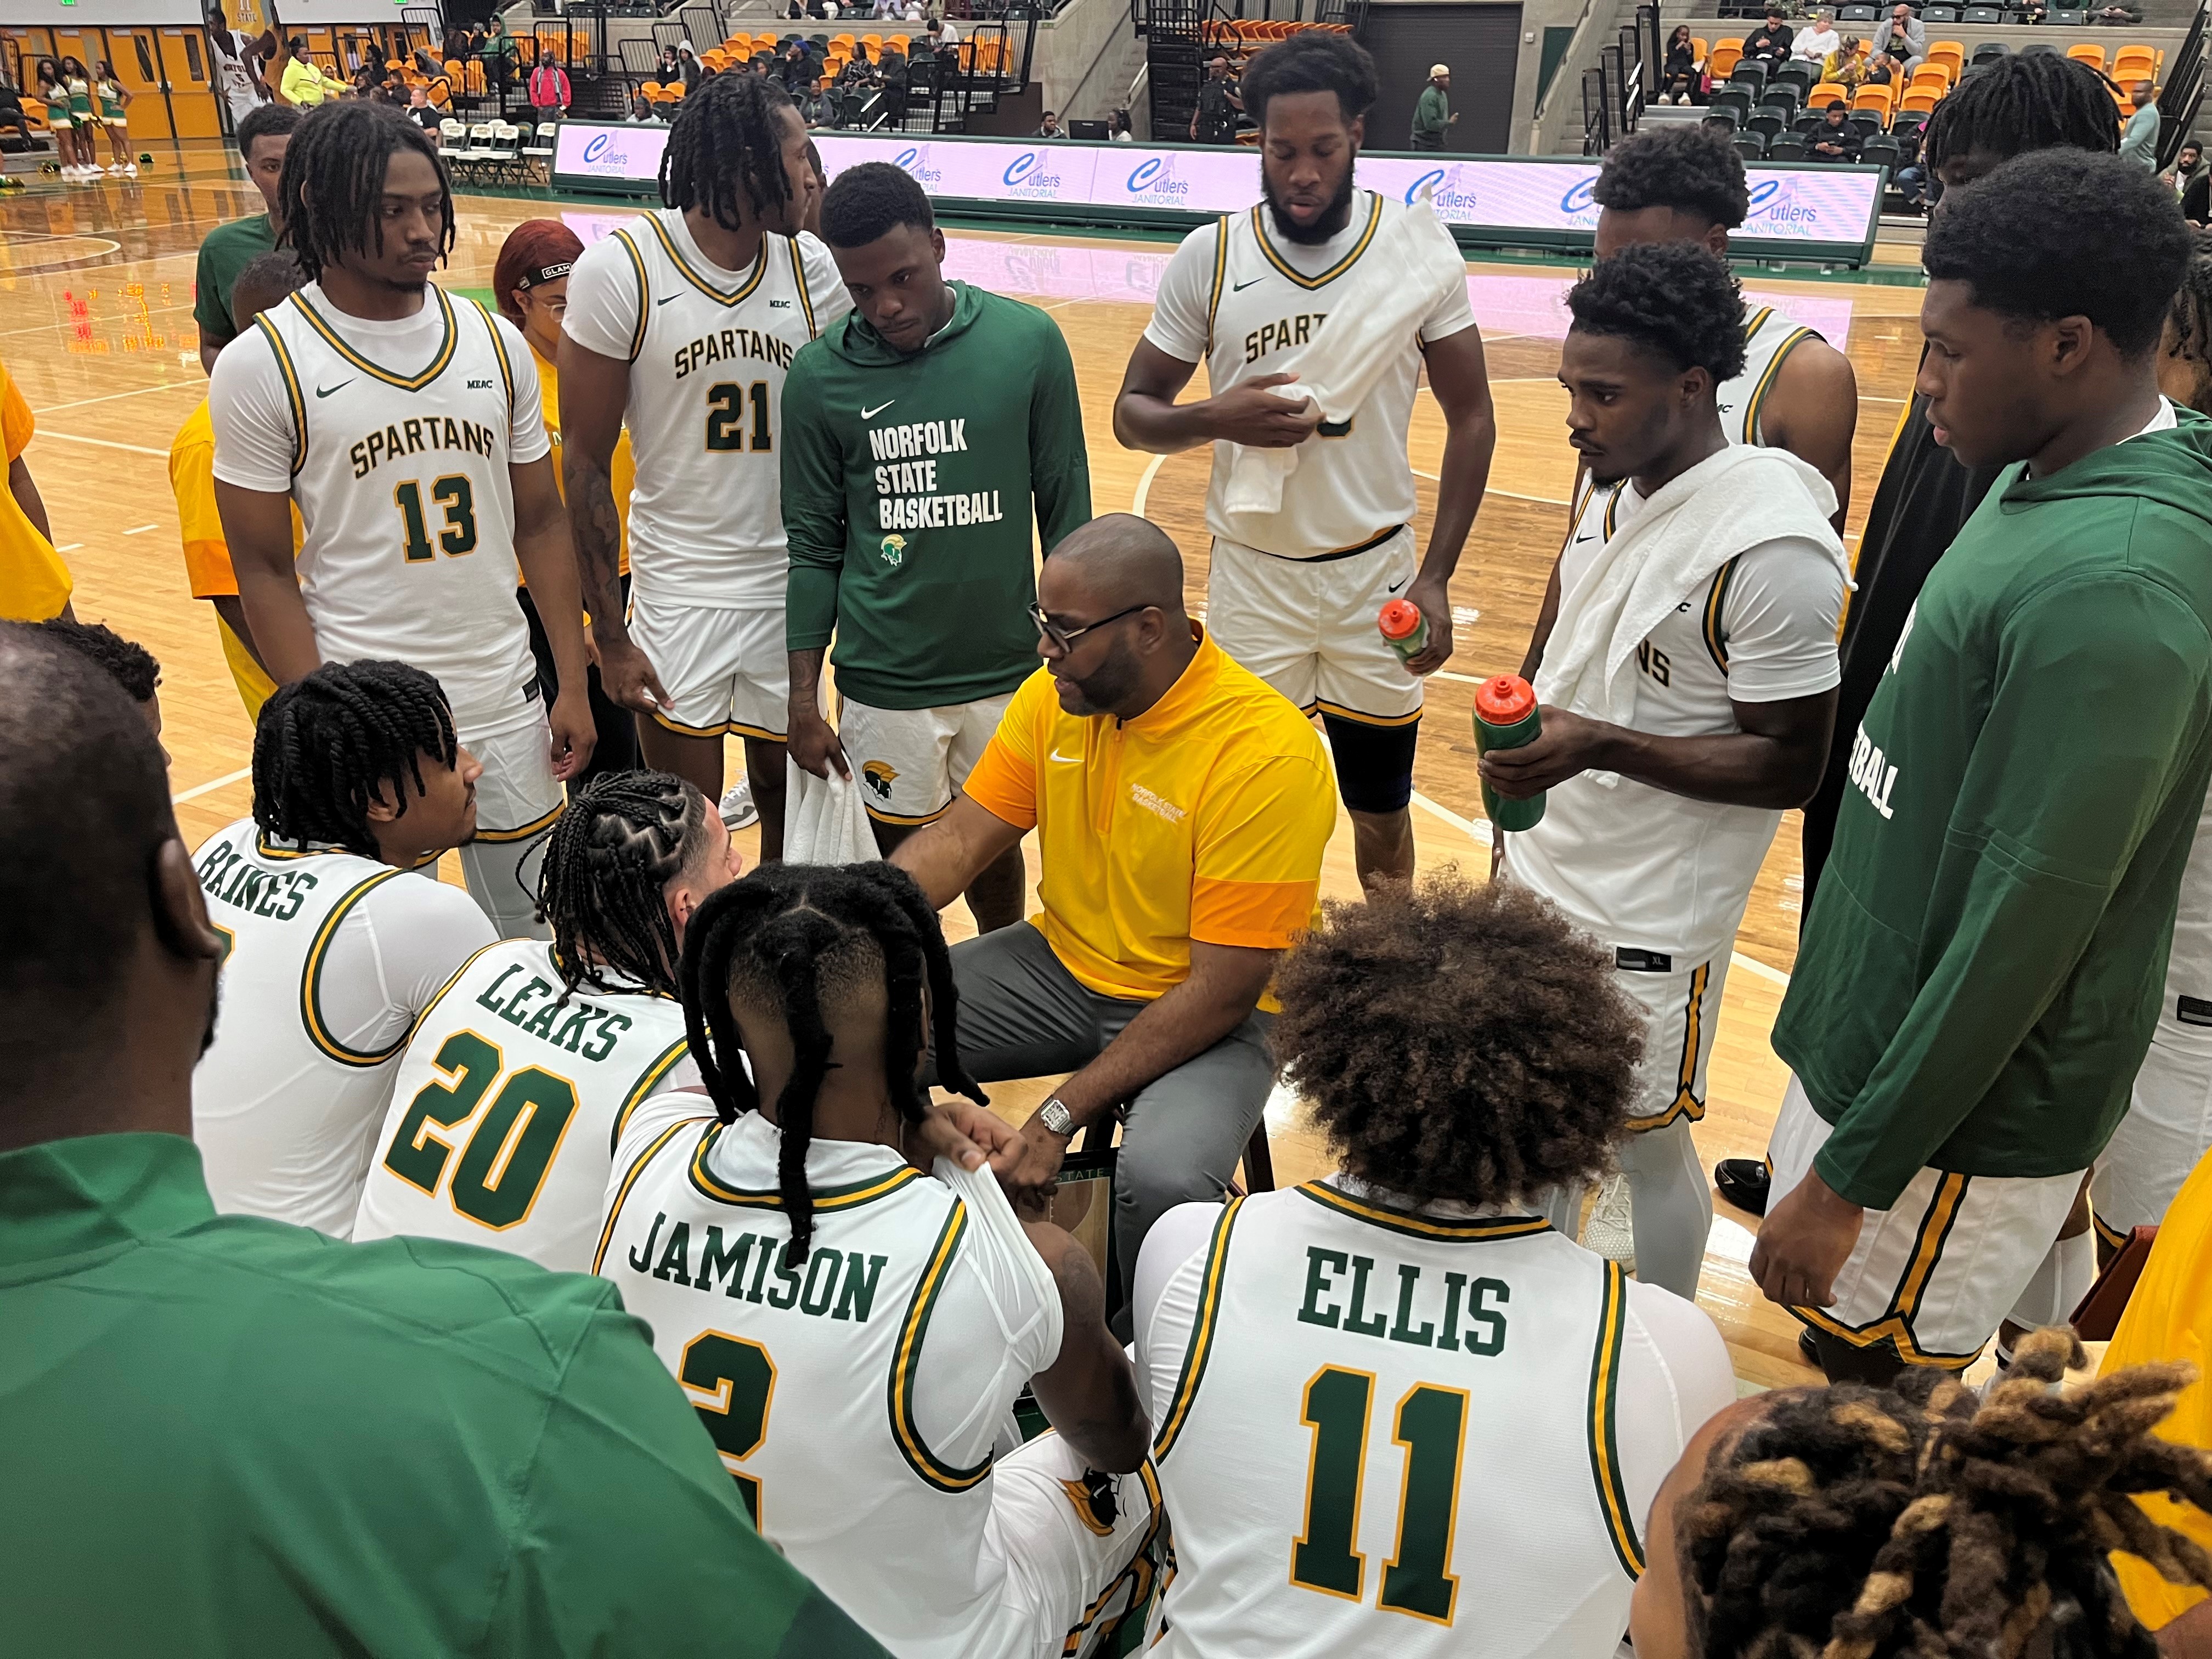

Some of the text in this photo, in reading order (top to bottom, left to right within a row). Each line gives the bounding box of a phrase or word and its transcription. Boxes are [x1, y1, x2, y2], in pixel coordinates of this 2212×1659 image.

[237, 13, 257, 22] STATE
[588, 165, 625, 174] JANITORIAL
[1008, 187, 1057, 199] JANITORIAL
[1132, 194, 1185, 206] JANITORIAL
[545, 265, 571, 275] GLAM
[770, 300, 790, 308] MEAC
[674, 329, 793, 379] SPARTANS
[1245, 313, 1329, 364] SPART
[467, 380, 493, 389] MEAC
[704, 380, 772, 453] 21
[349, 416, 494, 479] SPARTANS
[868, 419, 968, 461] NORFOLK
[875, 460, 937, 494] STATE
[393, 472, 479, 564] 13
[879, 490, 1003, 529] BASKETBALL
[1132, 783, 1186, 819] NORFOLK STATE
[1132, 793, 1177, 825] BASKETBALL
[196, 840, 318, 921] BAINES
[1652, 955, 1664, 966] XL
[475, 963, 632, 1062] LEAKS
[382, 1028, 580, 1233] 20
[629, 1211, 889, 1323] JAMISON
[1297, 1245, 1510, 1357] ELLIS
[1288, 1362, 1471, 1628] 11
